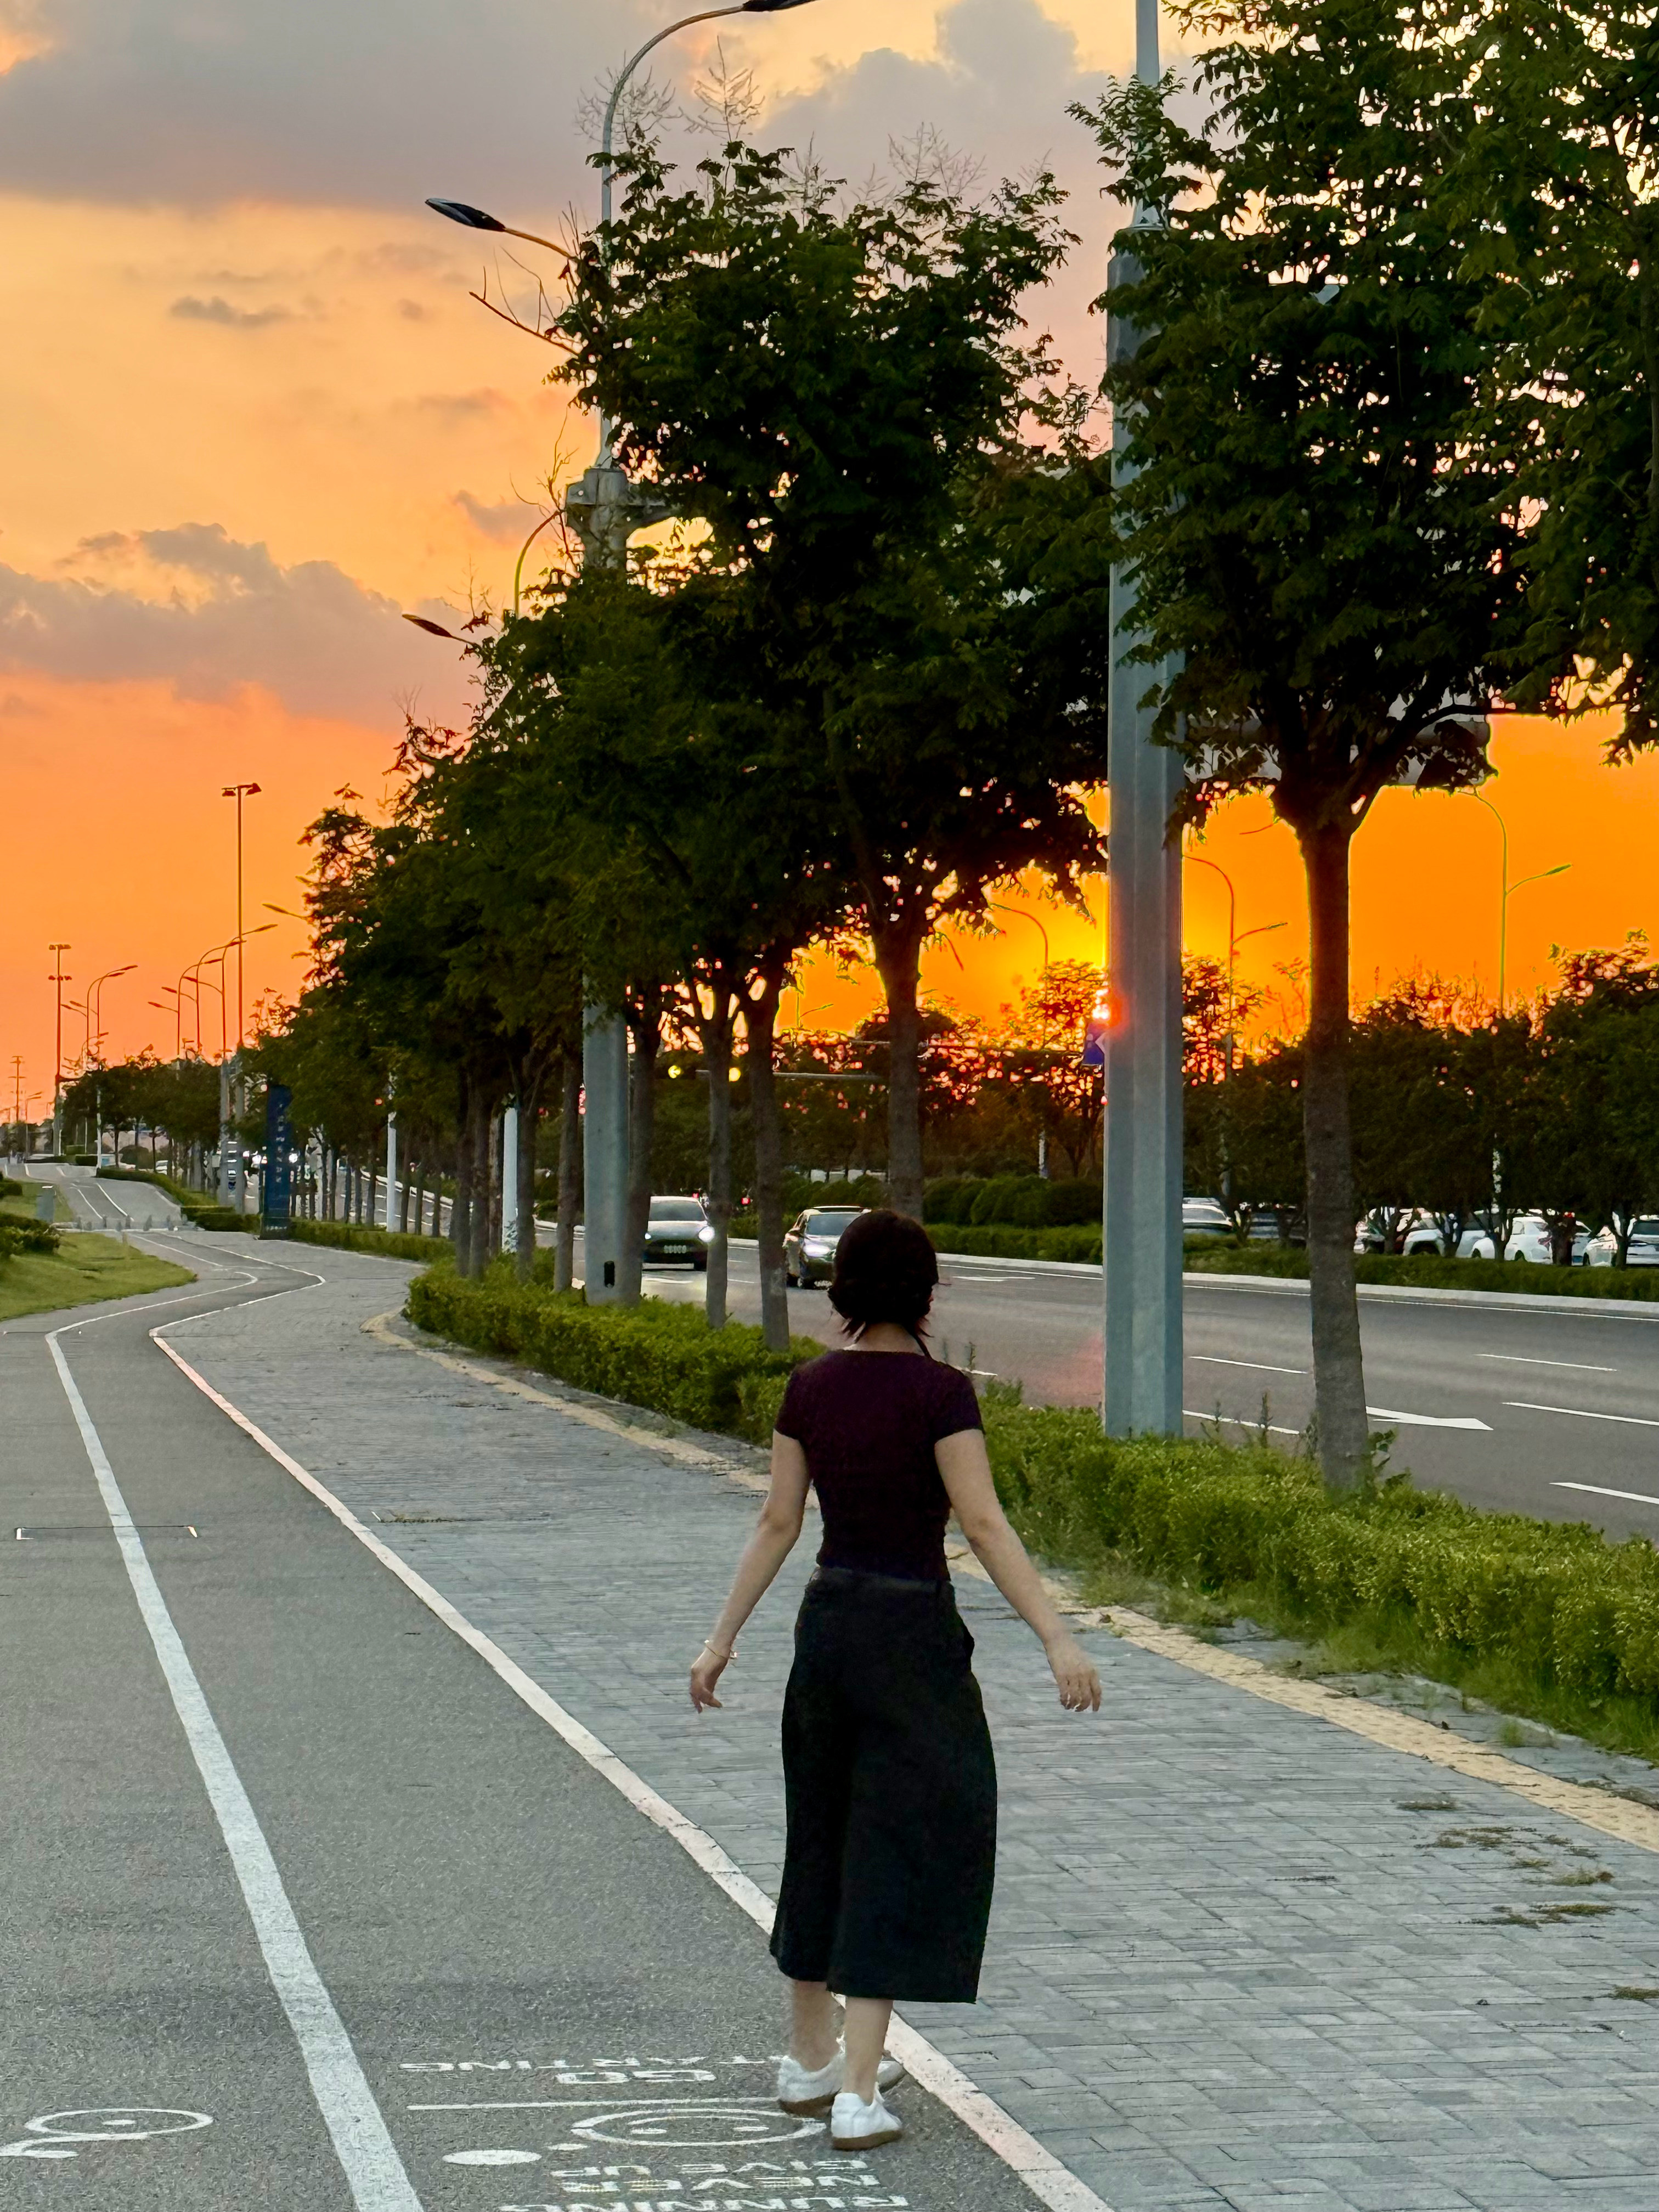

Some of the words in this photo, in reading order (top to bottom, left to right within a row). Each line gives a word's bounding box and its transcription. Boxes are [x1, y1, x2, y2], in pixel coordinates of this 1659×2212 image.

[399, 2056, 789, 2072] TARTING
[556, 2070, 716, 2084] GO
[550, 2165, 650, 2176] UP
[675, 2160, 868, 2173] GIVE
[561, 2175, 881, 2192] NEVER
[498, 2196, 909, 2212] RUNNING
